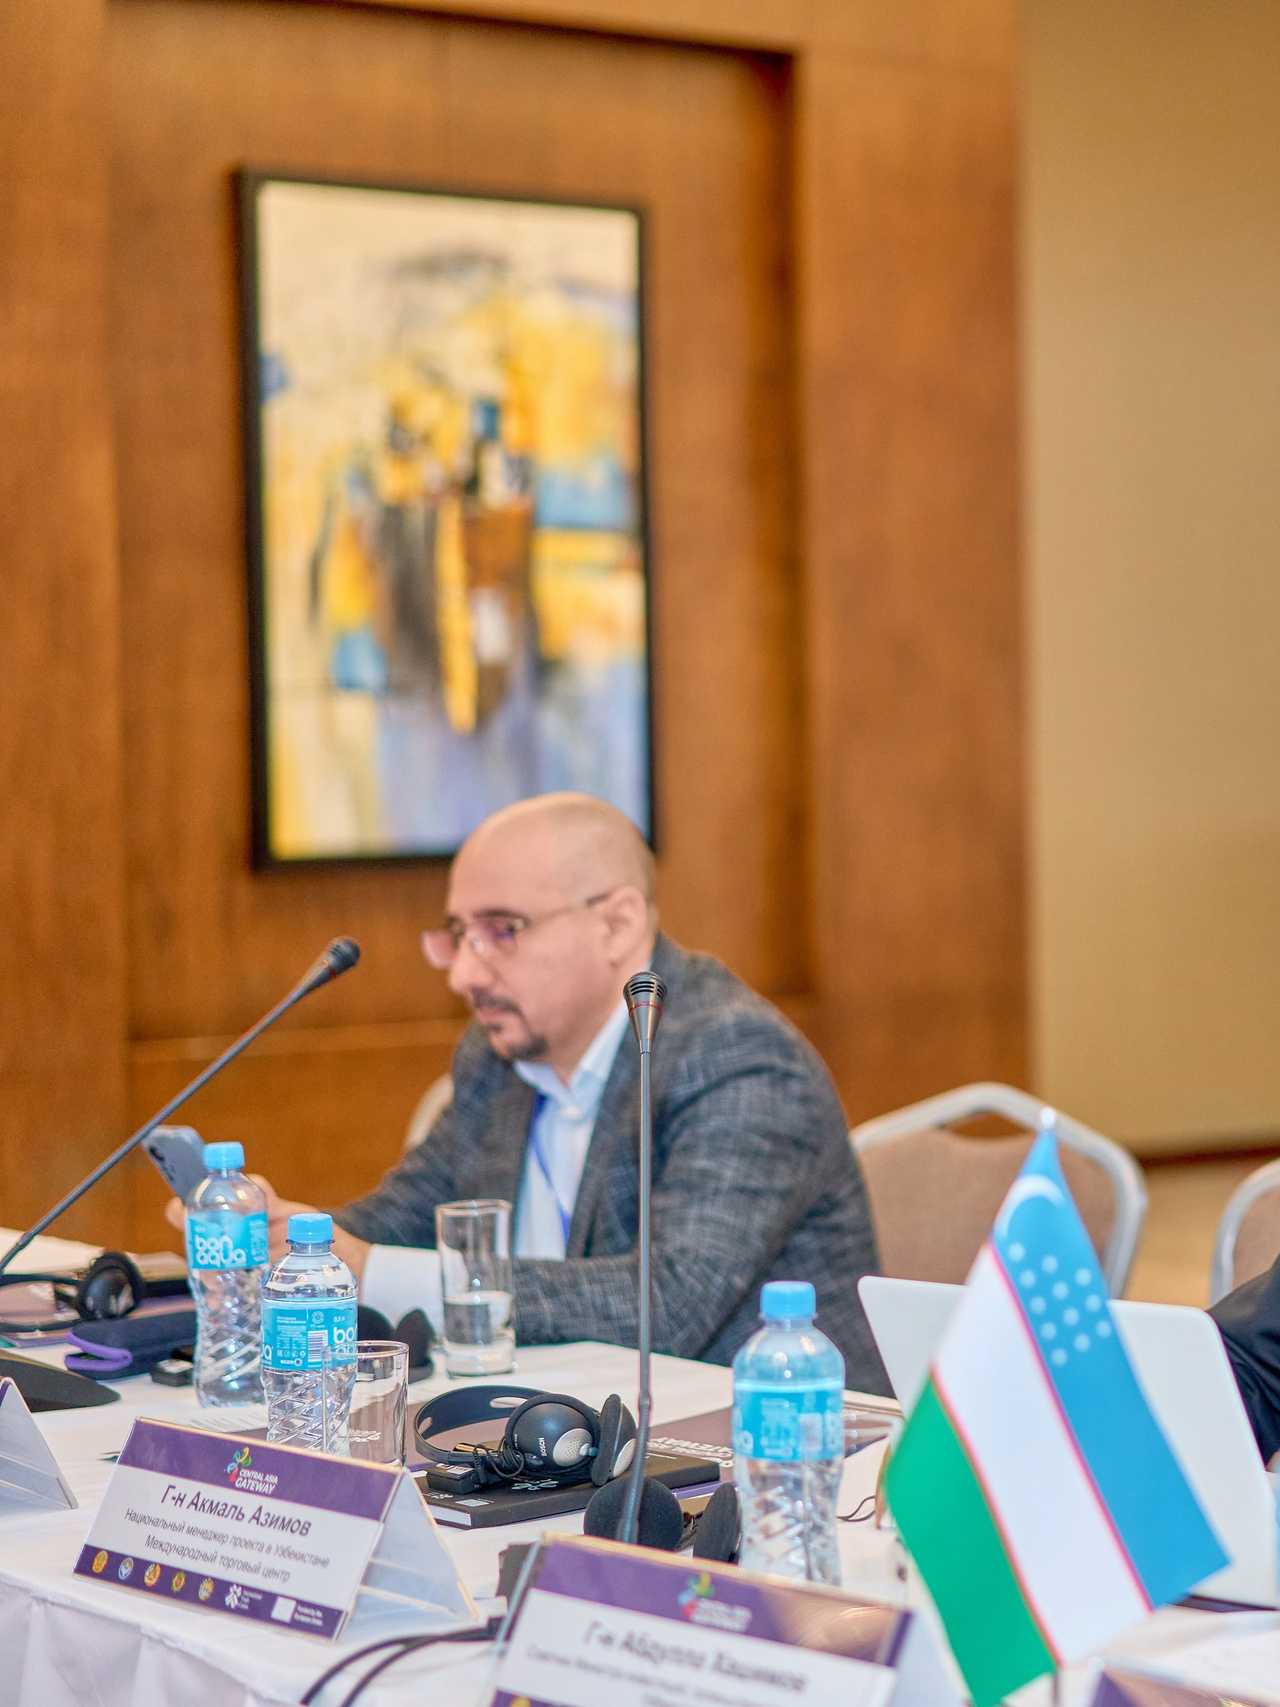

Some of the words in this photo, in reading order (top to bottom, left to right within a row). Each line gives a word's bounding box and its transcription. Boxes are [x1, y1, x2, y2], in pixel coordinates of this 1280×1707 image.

[195, 1233, 233, 1251] bon
[333, 1326, 357, 1344] bo
[538, 1437, 547, 1456] BOSCH
[239, 1468, 264, 1481] CENTRAL
[264, 1473, 278, 1484] ASIA
[235, 1477, 276, 1494] GATEWAY
[160, 1484, 187, 1508] Г-н
[186, 1491, 245, 1521] Акмаль
[248, 1505, 312, 1536] Азимов
[124, 1508, 186, 1533] Национальный
[186, 1525, 229, 1546] менеджер
[229, 1535, 265, 1553] проекта
[265, 1544, 273, 1554] в
[273, 1544, 330, 1568] Узбекистане
[144, 1534, 218, 1564] Международный
[218, 1555, 261, 1575] торговый
[262, 1566, 291, 1584] центр
